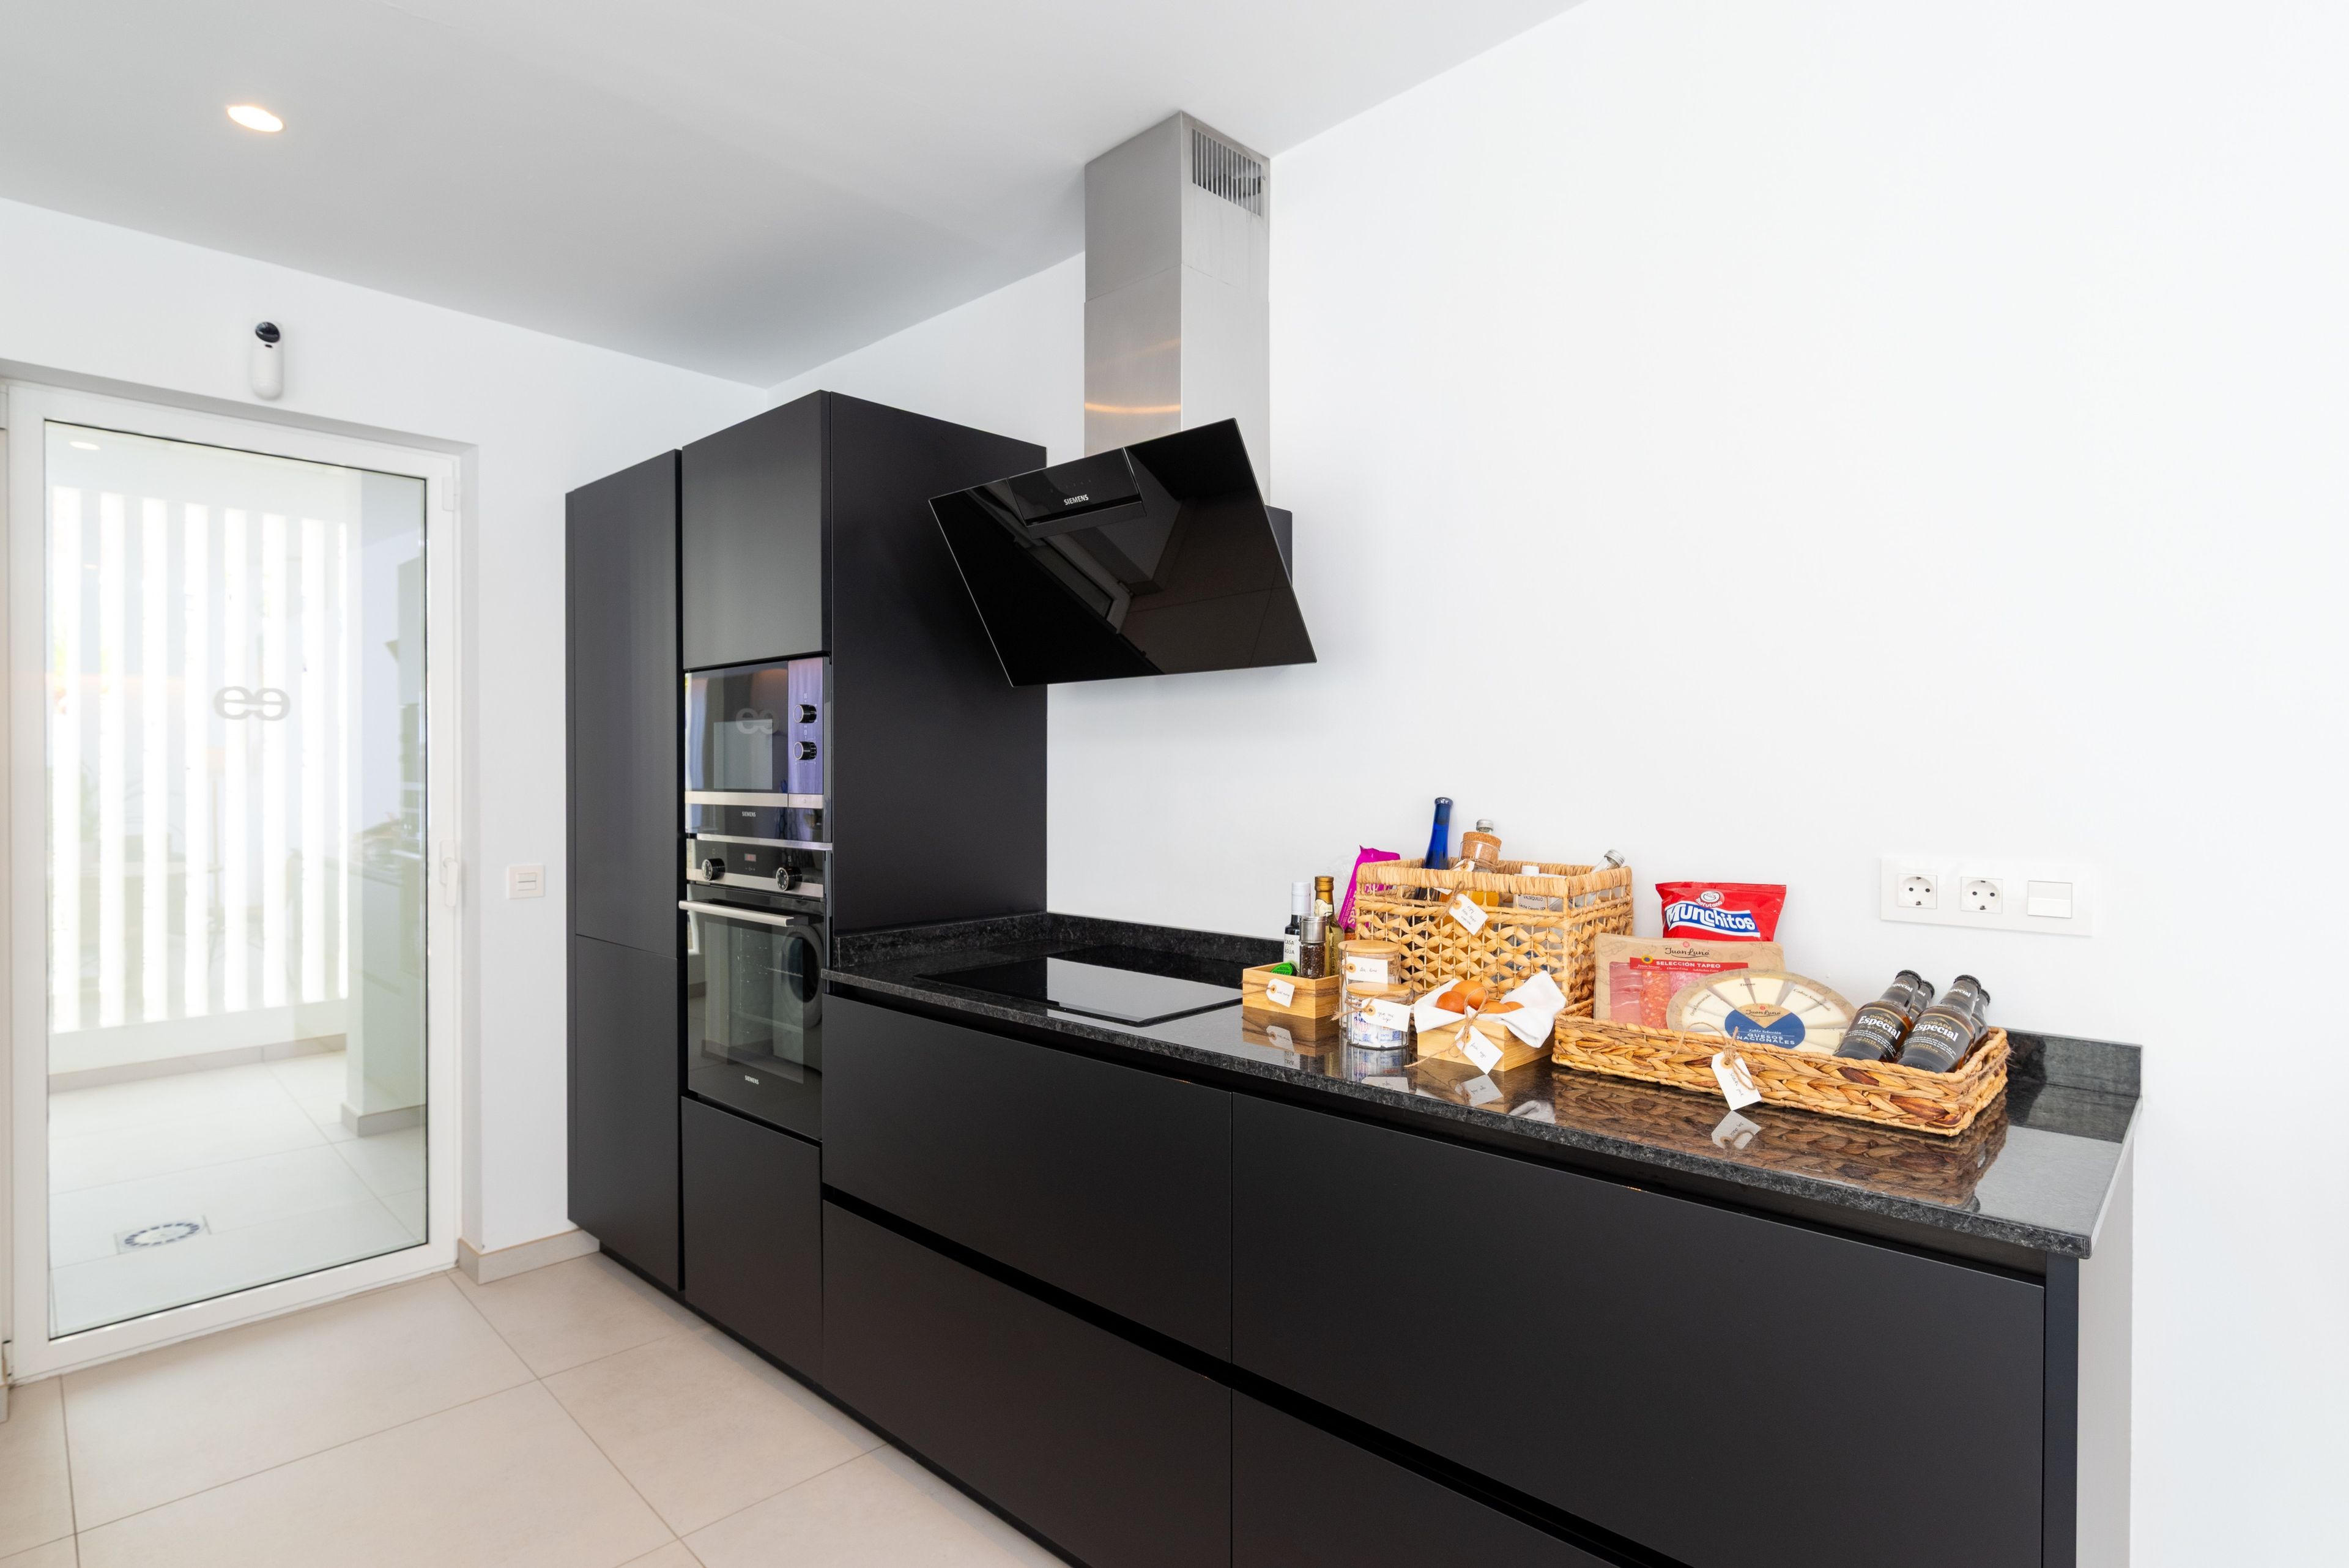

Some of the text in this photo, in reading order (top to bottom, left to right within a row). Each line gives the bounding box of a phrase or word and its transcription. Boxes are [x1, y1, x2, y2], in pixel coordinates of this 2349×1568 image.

[1064, 494, 1089, 505] SIEMENS
[1666, 904, 1756, 931] Munchitos
[1664, 947, 1687, 956] Juan
[1869, 1014, 1896, 1028] DORADA
[1923, 1020, 1952, 1031] DORADA
[1857, 1016, 1901, 1040] Especial
[1912, 1023, 1959, 1042] Especial
[1737, 1036, 1795, 1045] NACIONALES
